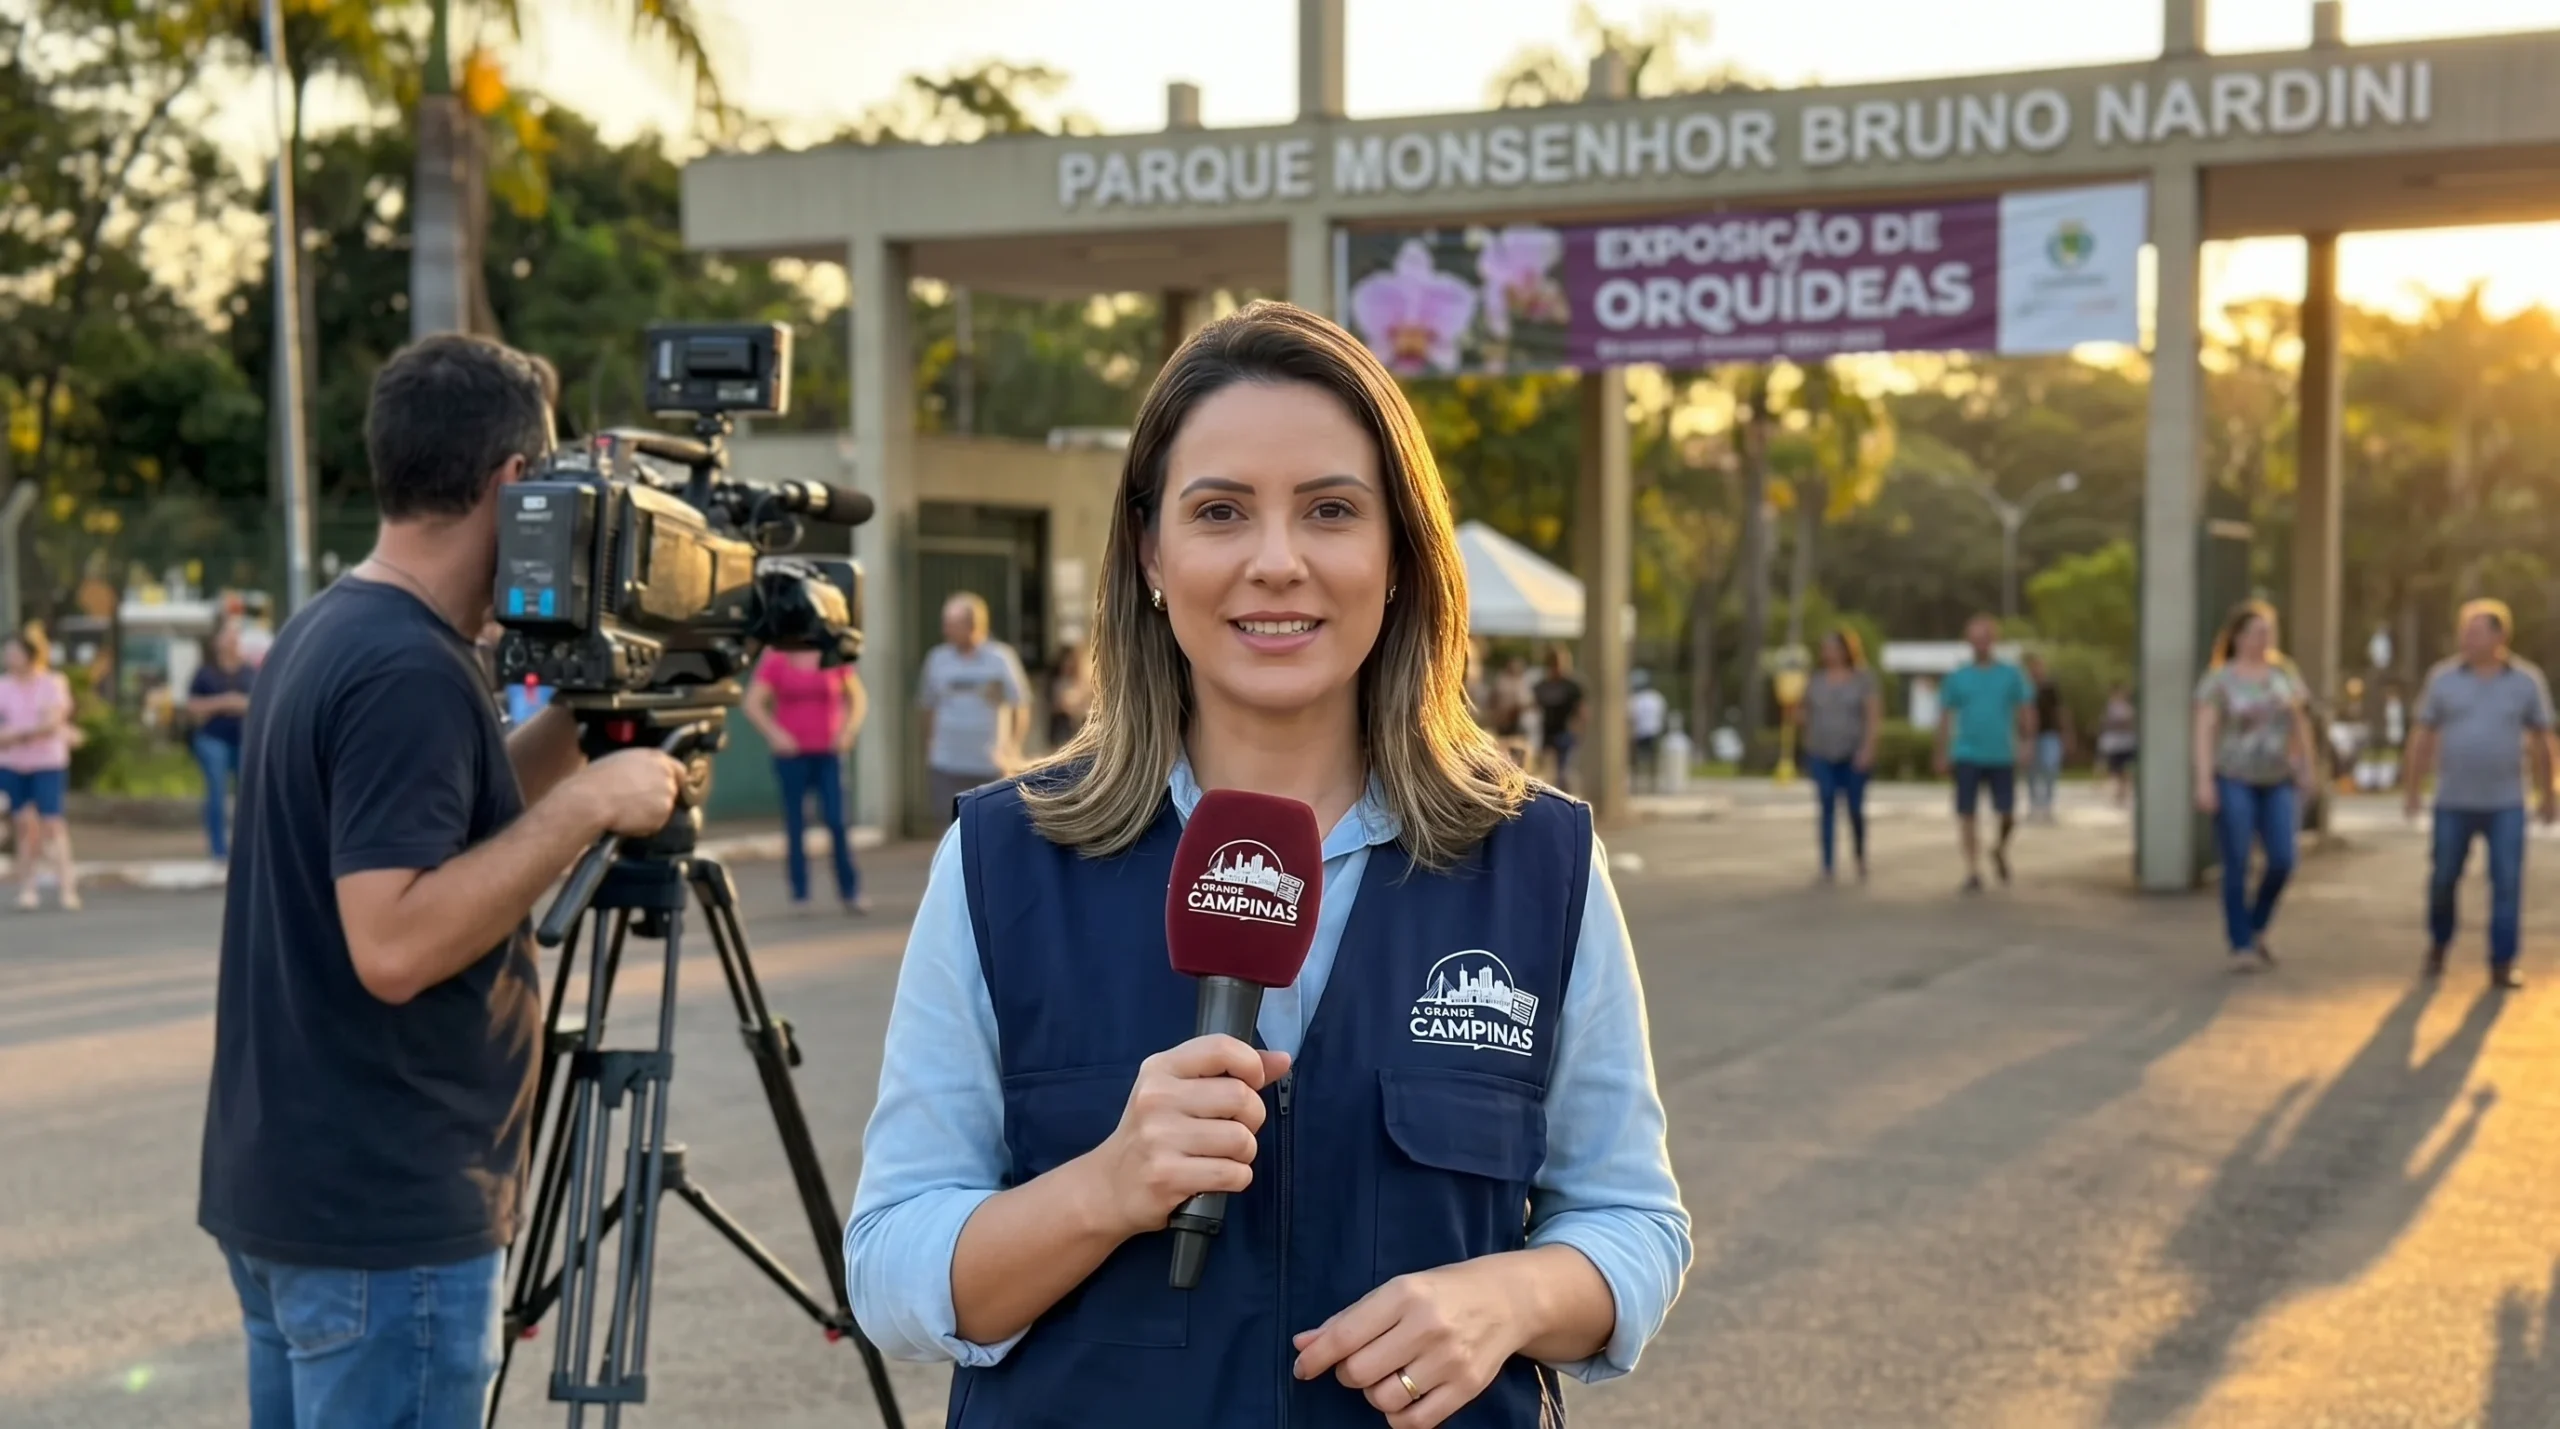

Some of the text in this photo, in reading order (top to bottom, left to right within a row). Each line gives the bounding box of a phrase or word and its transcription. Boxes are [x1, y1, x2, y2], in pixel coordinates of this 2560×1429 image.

[1058, 60, 2433, 206] PARQUE MONSENHOR BRUNO NARDINI
[1595, 210, 1942, 269] EXPOSIÇÃO DE
[1594, 258, 1975, 334] ORQUÍDEAS
[1192, 882, 1244, 896] A GRANDE
[1188, 891, 1298, 921] CAMPINAS
[1411, 1006, 1475, 1018] A GRANDE
[1410, 1017, 1533, 1050] CAMPINAS
